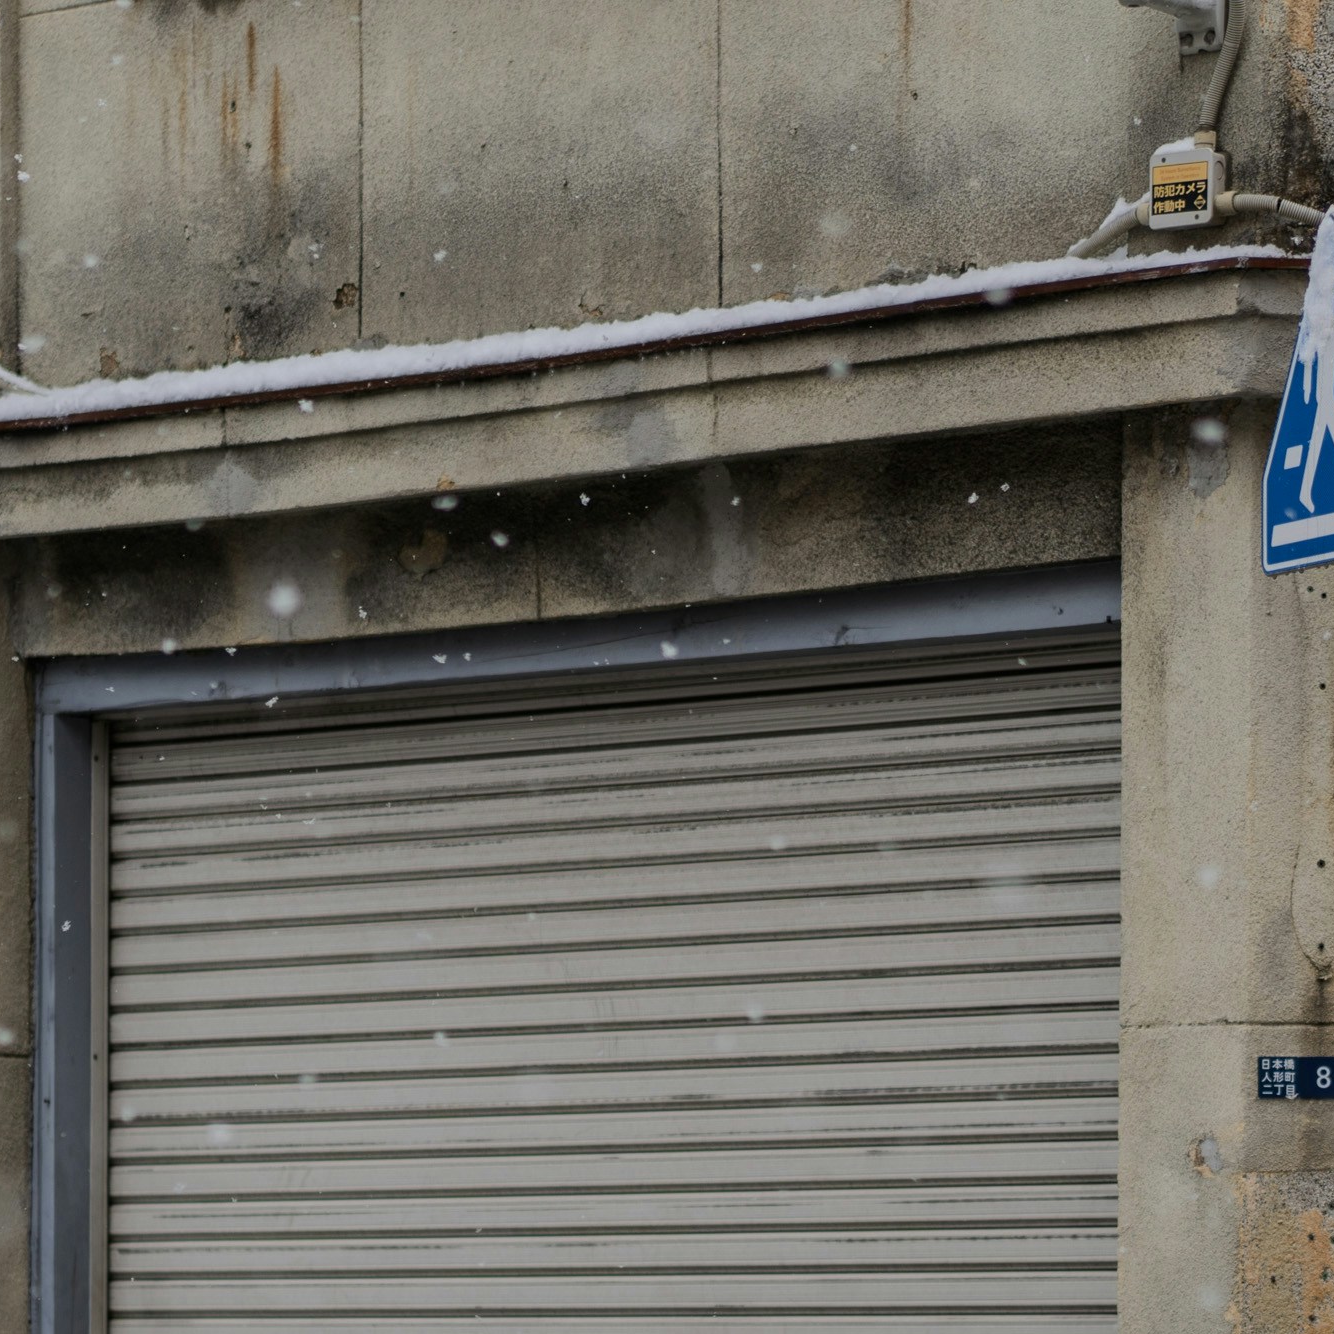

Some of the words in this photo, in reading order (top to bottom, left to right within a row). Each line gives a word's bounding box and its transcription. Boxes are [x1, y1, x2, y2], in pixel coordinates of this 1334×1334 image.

[1154, 182, 1205, 198] 防犯カメラ
[1154, 199, 1185, 213] 作動中
[1261, 1058, 1295, 1070] 日本橋
[1261, 1071, 1296, 1083] 人形町
[1262, 1084, 1296, 1098] 二丁目
